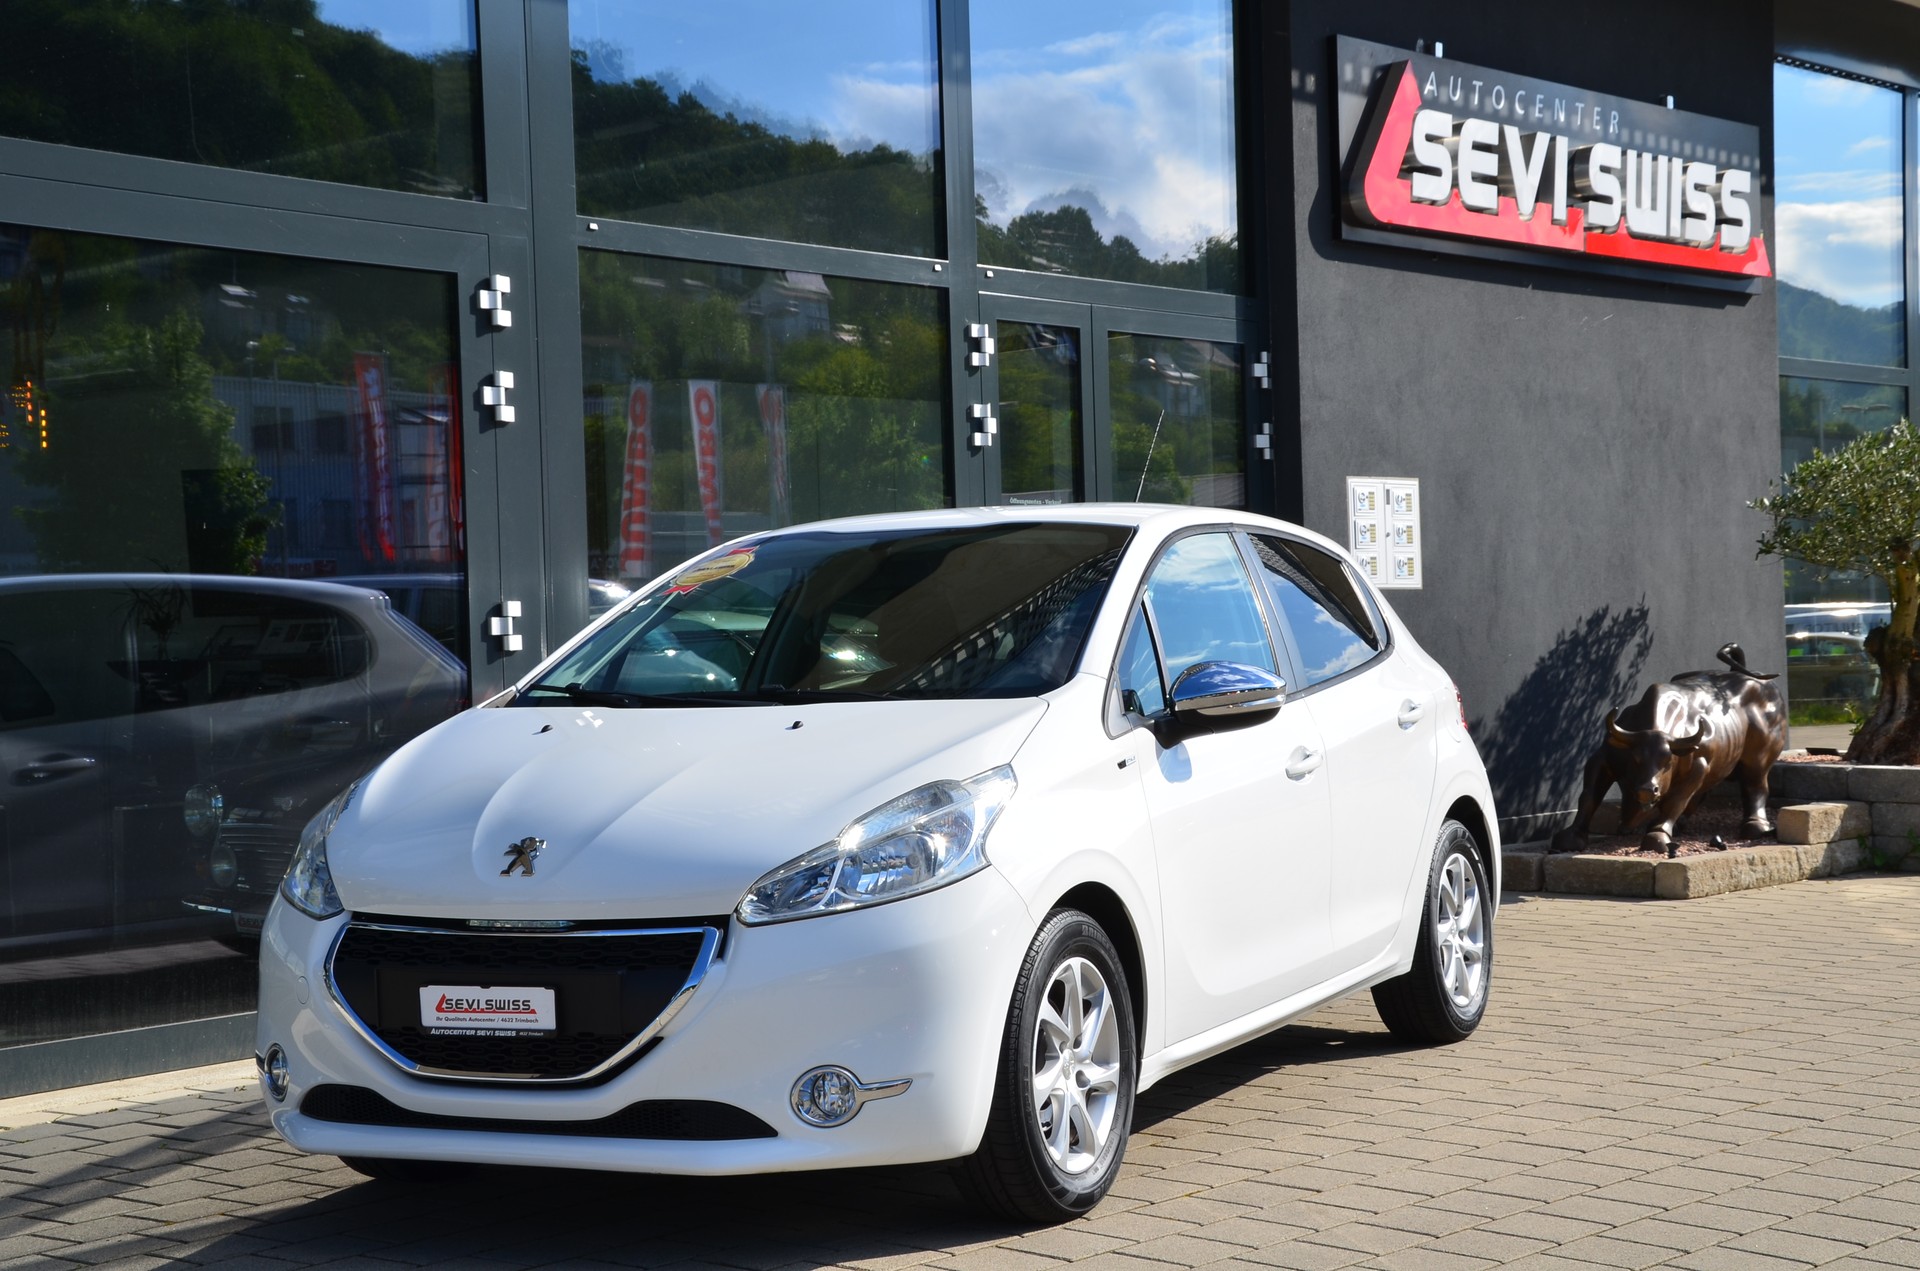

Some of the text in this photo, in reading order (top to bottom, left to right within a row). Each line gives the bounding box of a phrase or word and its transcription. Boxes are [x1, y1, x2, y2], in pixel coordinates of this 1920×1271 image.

[1424, 71, 1620, 134] AUTOCENTER
[1411, 108, 1752, 248] SEVI SWISS
[445, 998, 531, 1011] SEVI SWISS
[430, 1028, 476, 1036] AUTOCENTER
